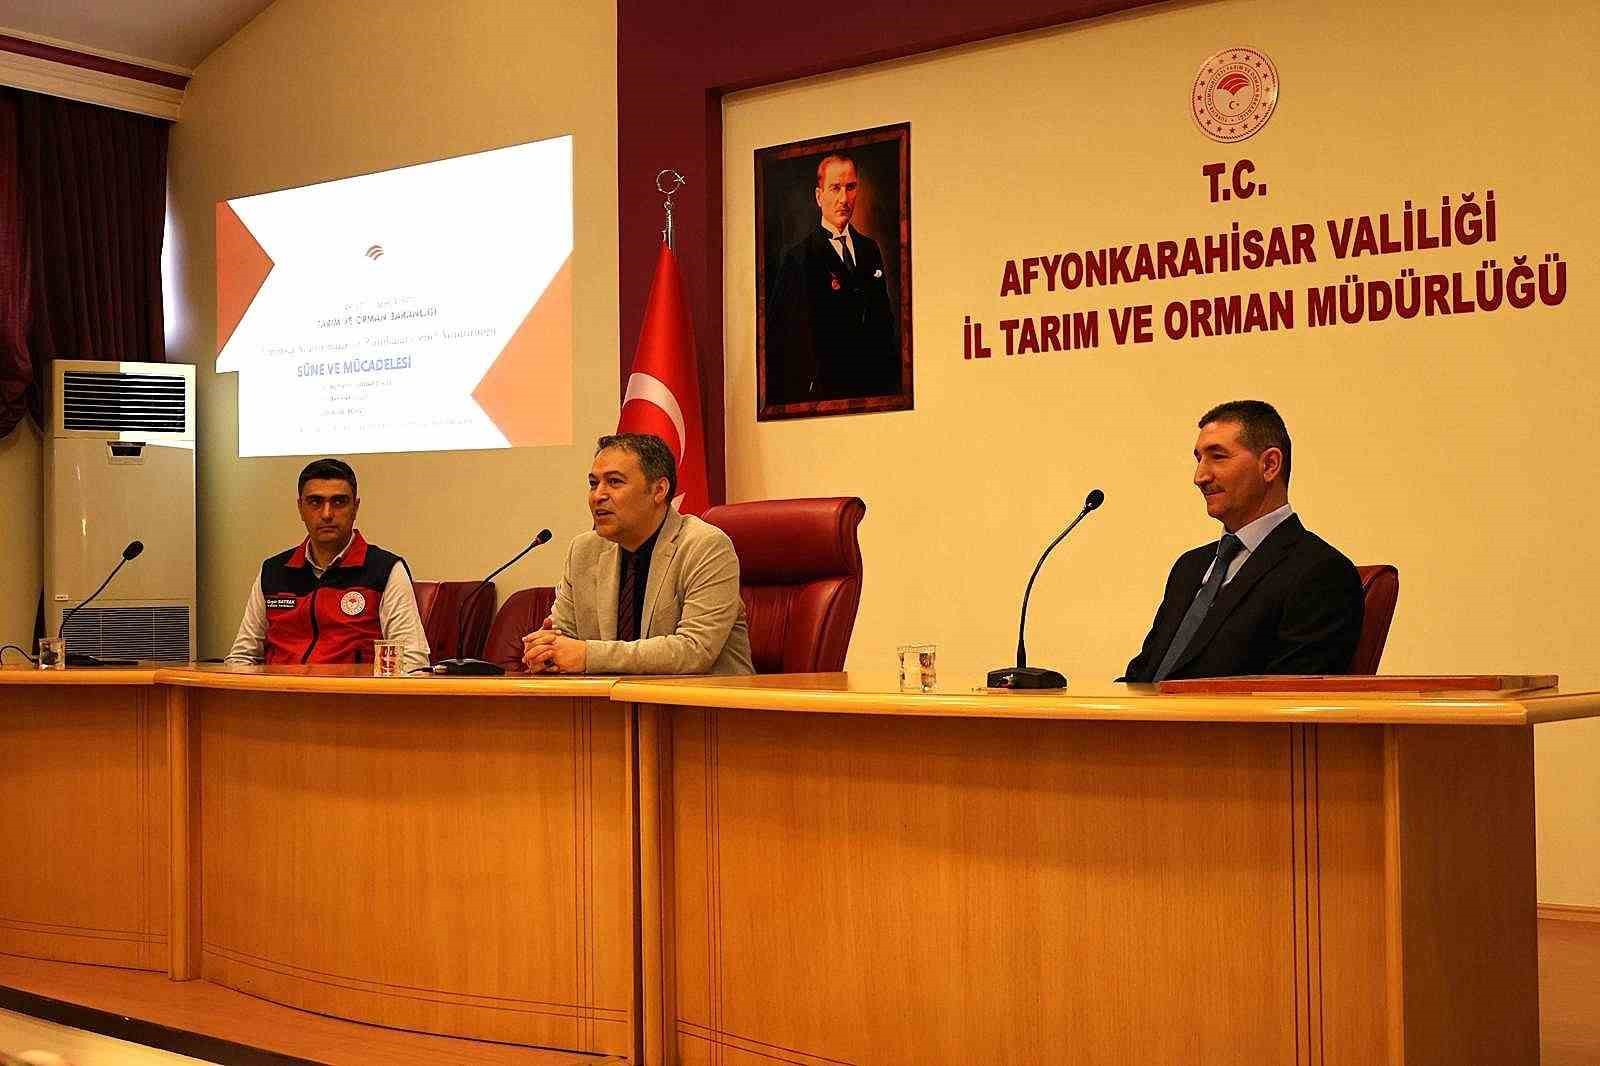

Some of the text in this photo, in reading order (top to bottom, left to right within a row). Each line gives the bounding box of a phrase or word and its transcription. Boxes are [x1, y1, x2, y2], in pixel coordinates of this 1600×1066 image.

[1203, 160, 1267, 203] T.C.
[1001, 190, 1497, 297] AFYONKARAHİSAR VALİLİĞİ
[964, 252, 1567, 360] İL TARIM VE ORMAN MÜDÜRLÜĞÜ
[296, 353, 412, 378] SÜNE VE MÜCADELESİ
